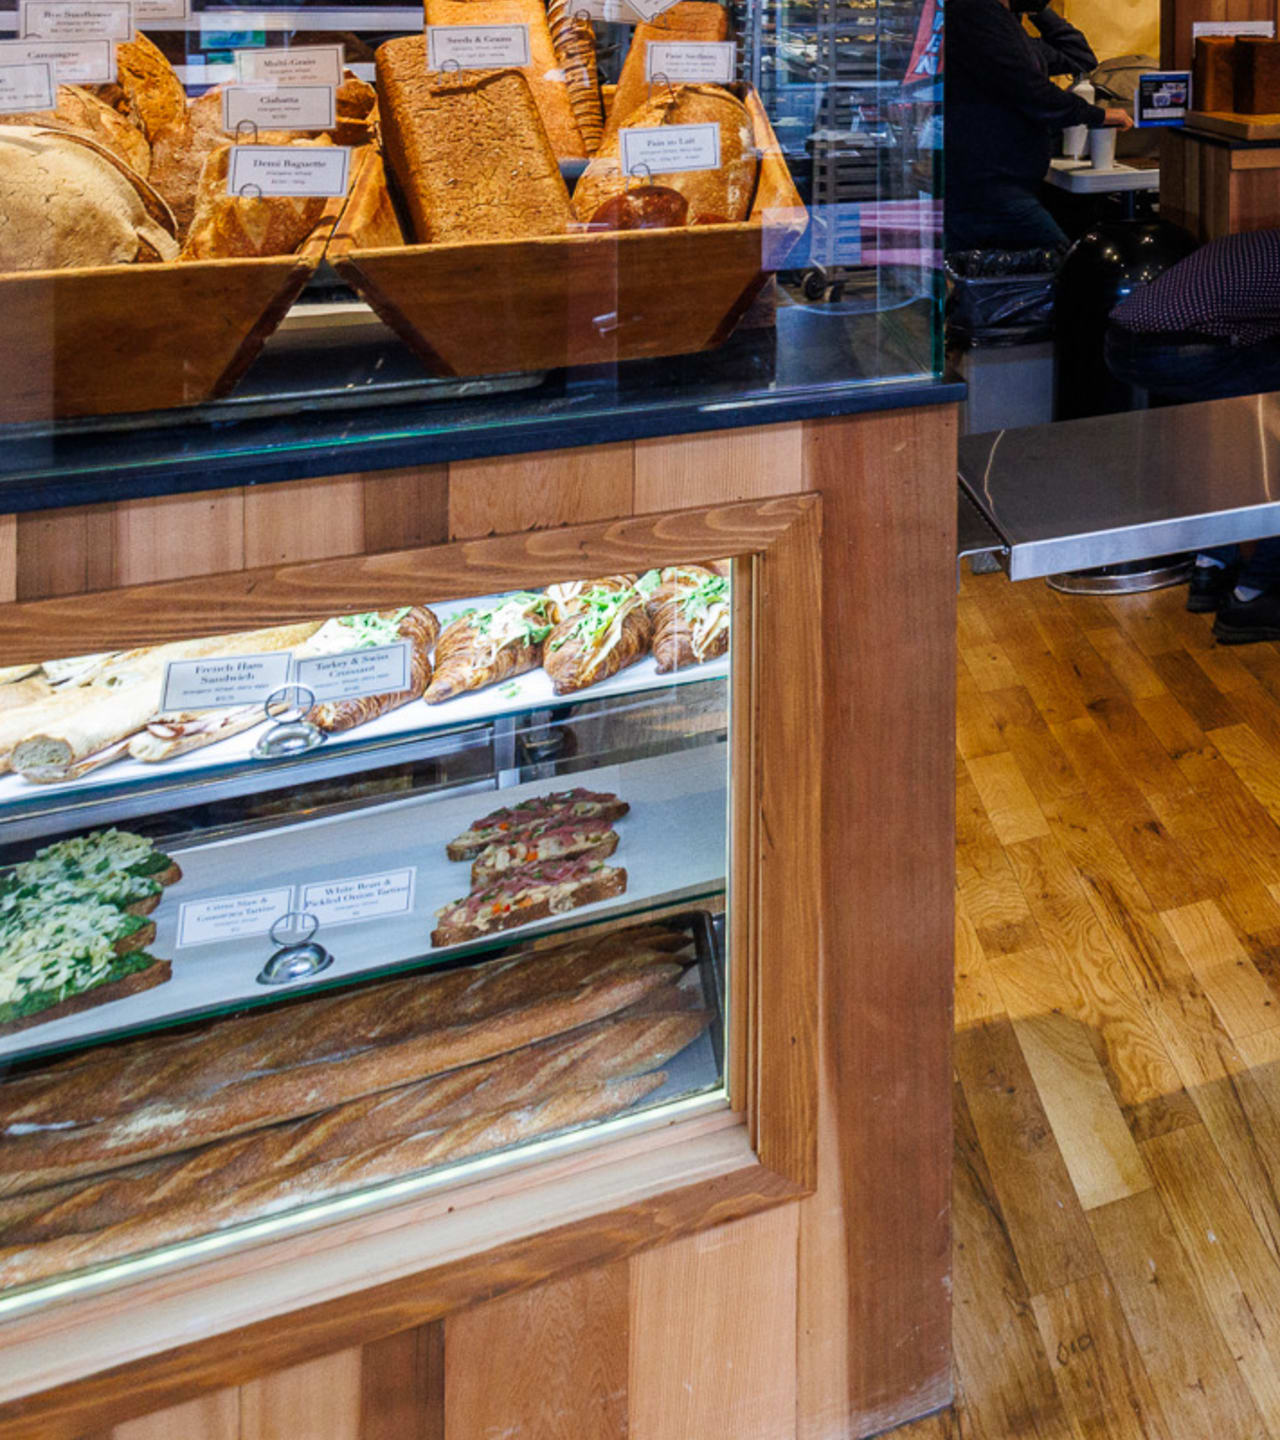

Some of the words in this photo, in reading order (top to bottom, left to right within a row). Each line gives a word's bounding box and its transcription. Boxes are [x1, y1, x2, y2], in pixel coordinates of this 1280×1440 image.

[253, 158, 282, 169] Demi
[283, 158, 327, 171] Baguette
[195, 663, 234, 675] French
[237, 661, 264, 672] Ham
[316, 660, 348, 672] Turkey
[350, 658, 359, 667] &
[200, 673, 256, 686] Sandwich
[325, 886, 355, 897] White
[384, 879, 392, 888] &
